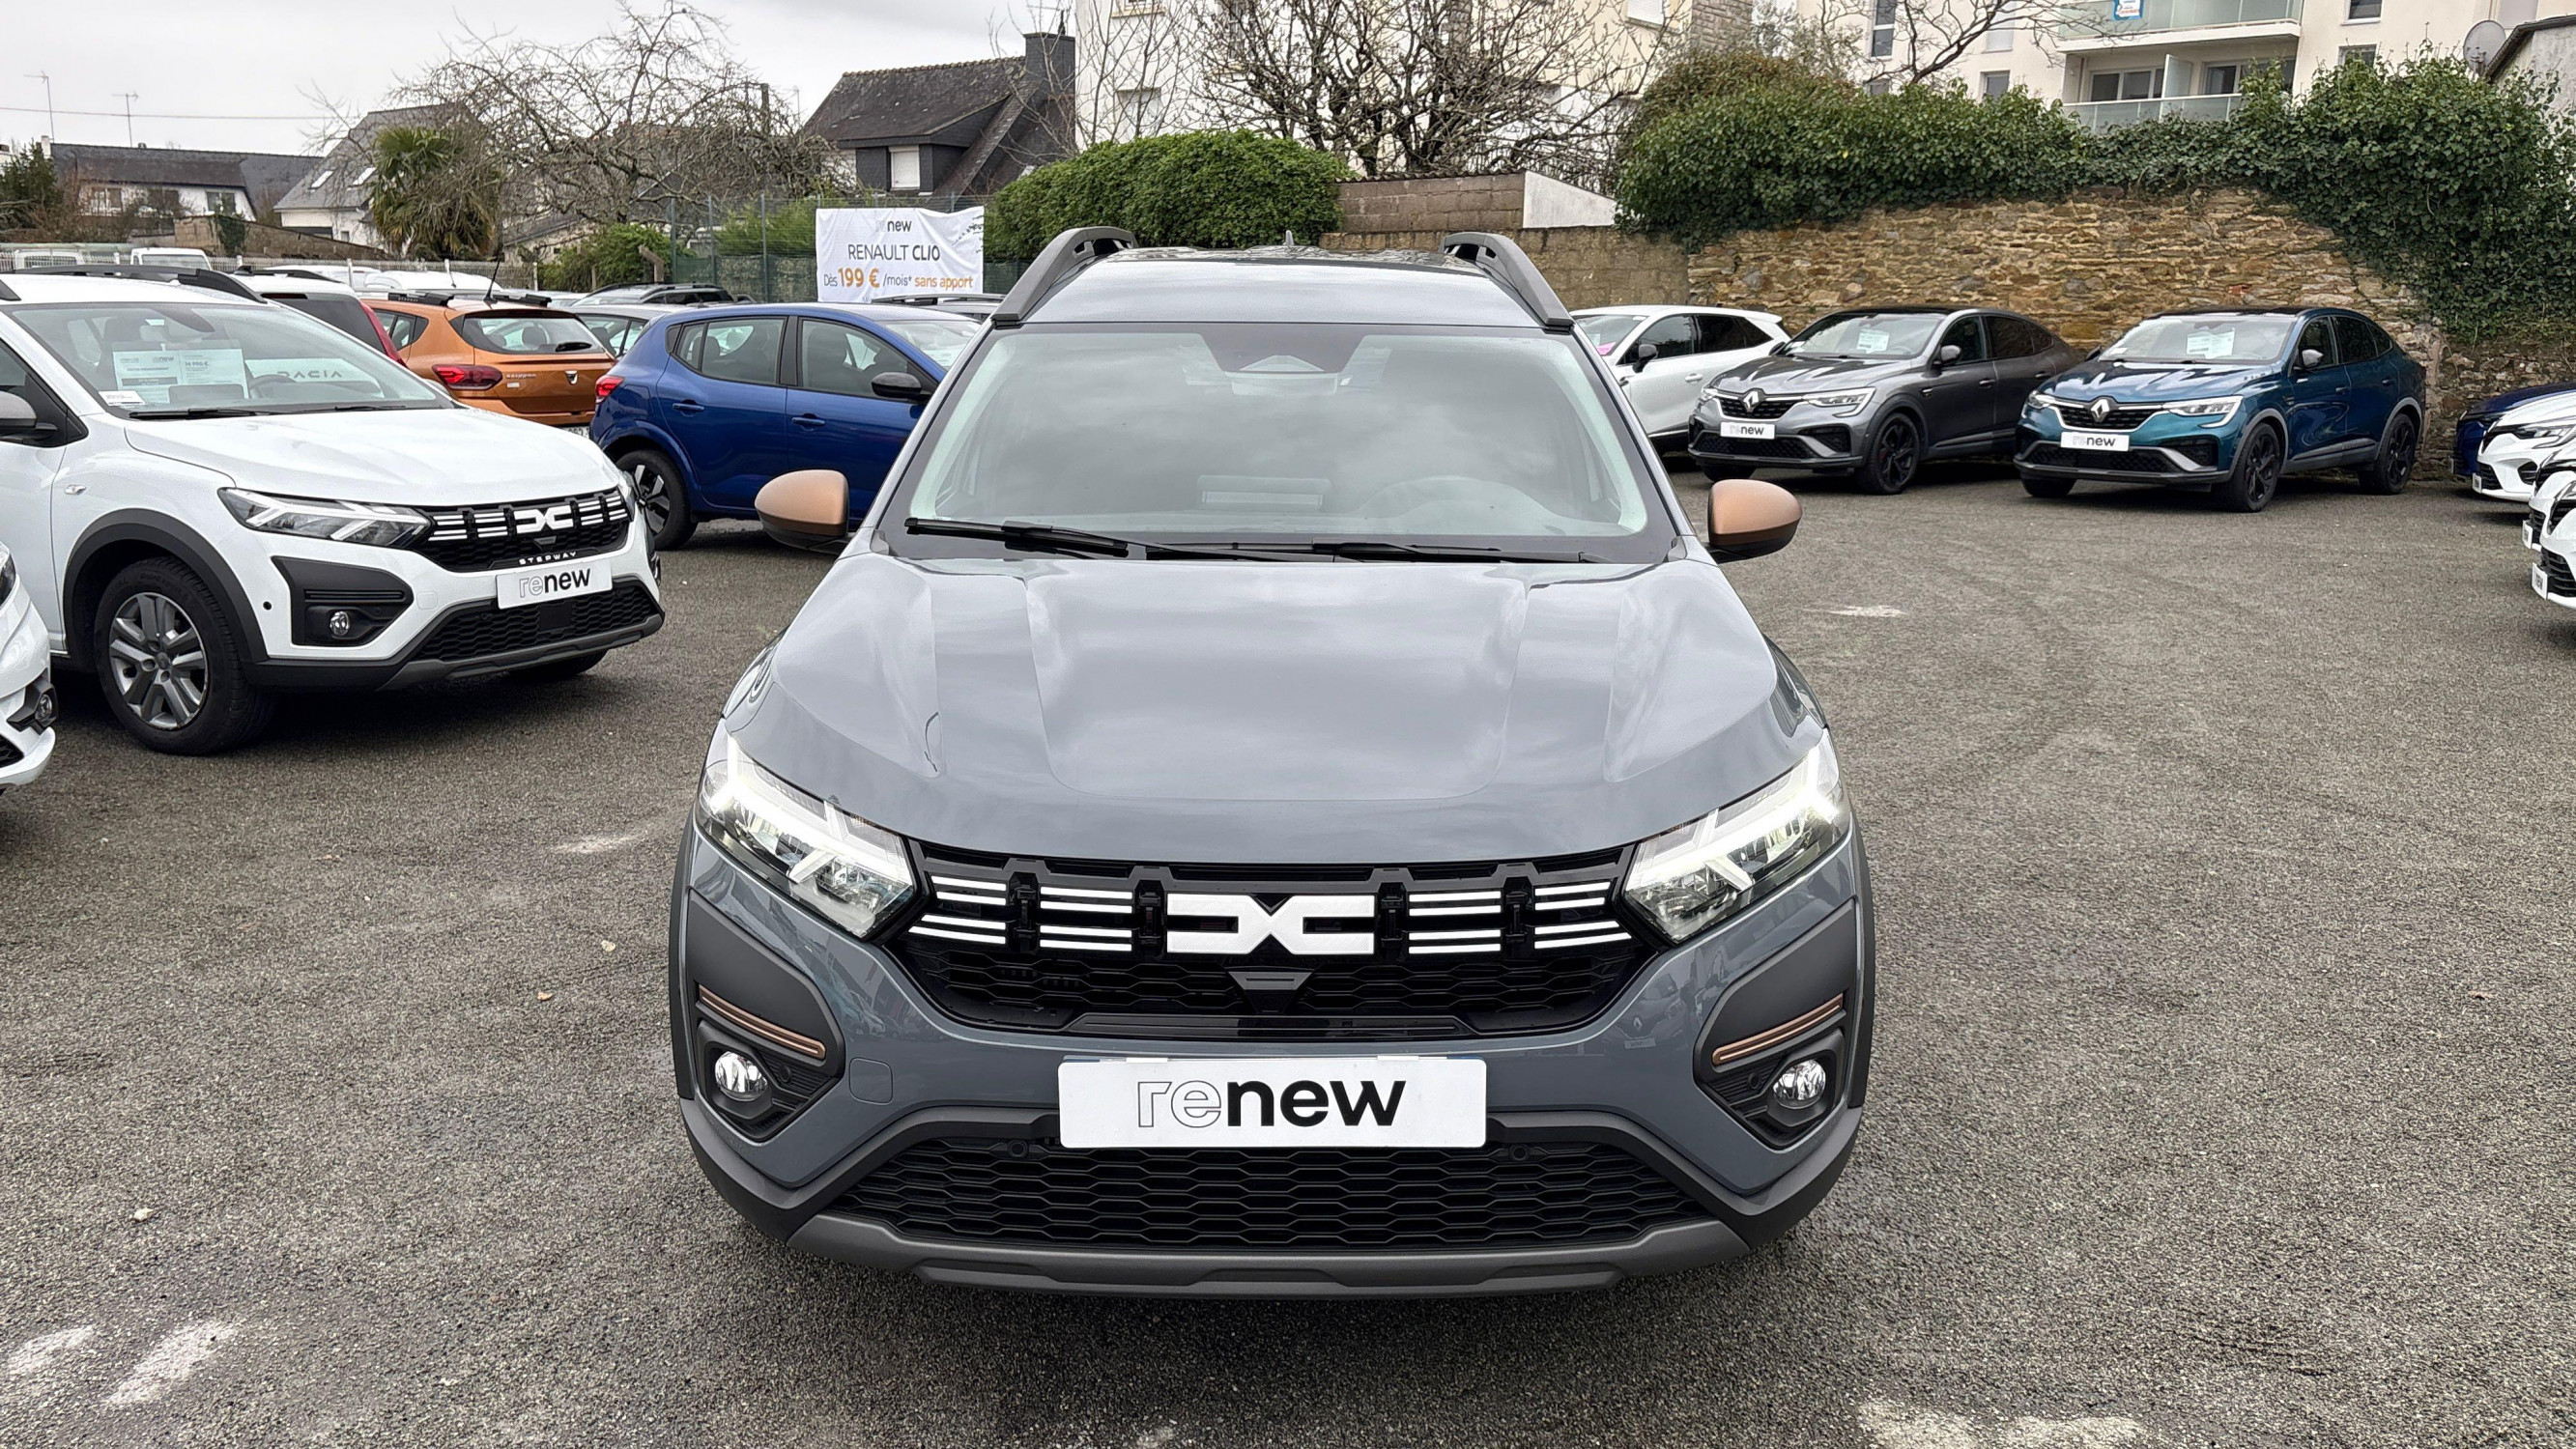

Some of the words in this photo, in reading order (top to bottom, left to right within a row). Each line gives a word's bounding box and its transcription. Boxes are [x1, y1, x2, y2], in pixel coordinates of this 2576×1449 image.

[848, 243, 909, 262] RENAULT
[911, 244, 940, 262] CLIO
[823, 273, 839, 287] Dès
[838, 267, 865, 288] 199
[868, 268, 880, 289] €
[914, 276, 937, 288] sans
[939, 275, 973, 291] apport
[519, 551, 577, 565] STEPWAY
[519, 568, 591, 598] renew
[1136, 1079, 1407, 1129] renew
